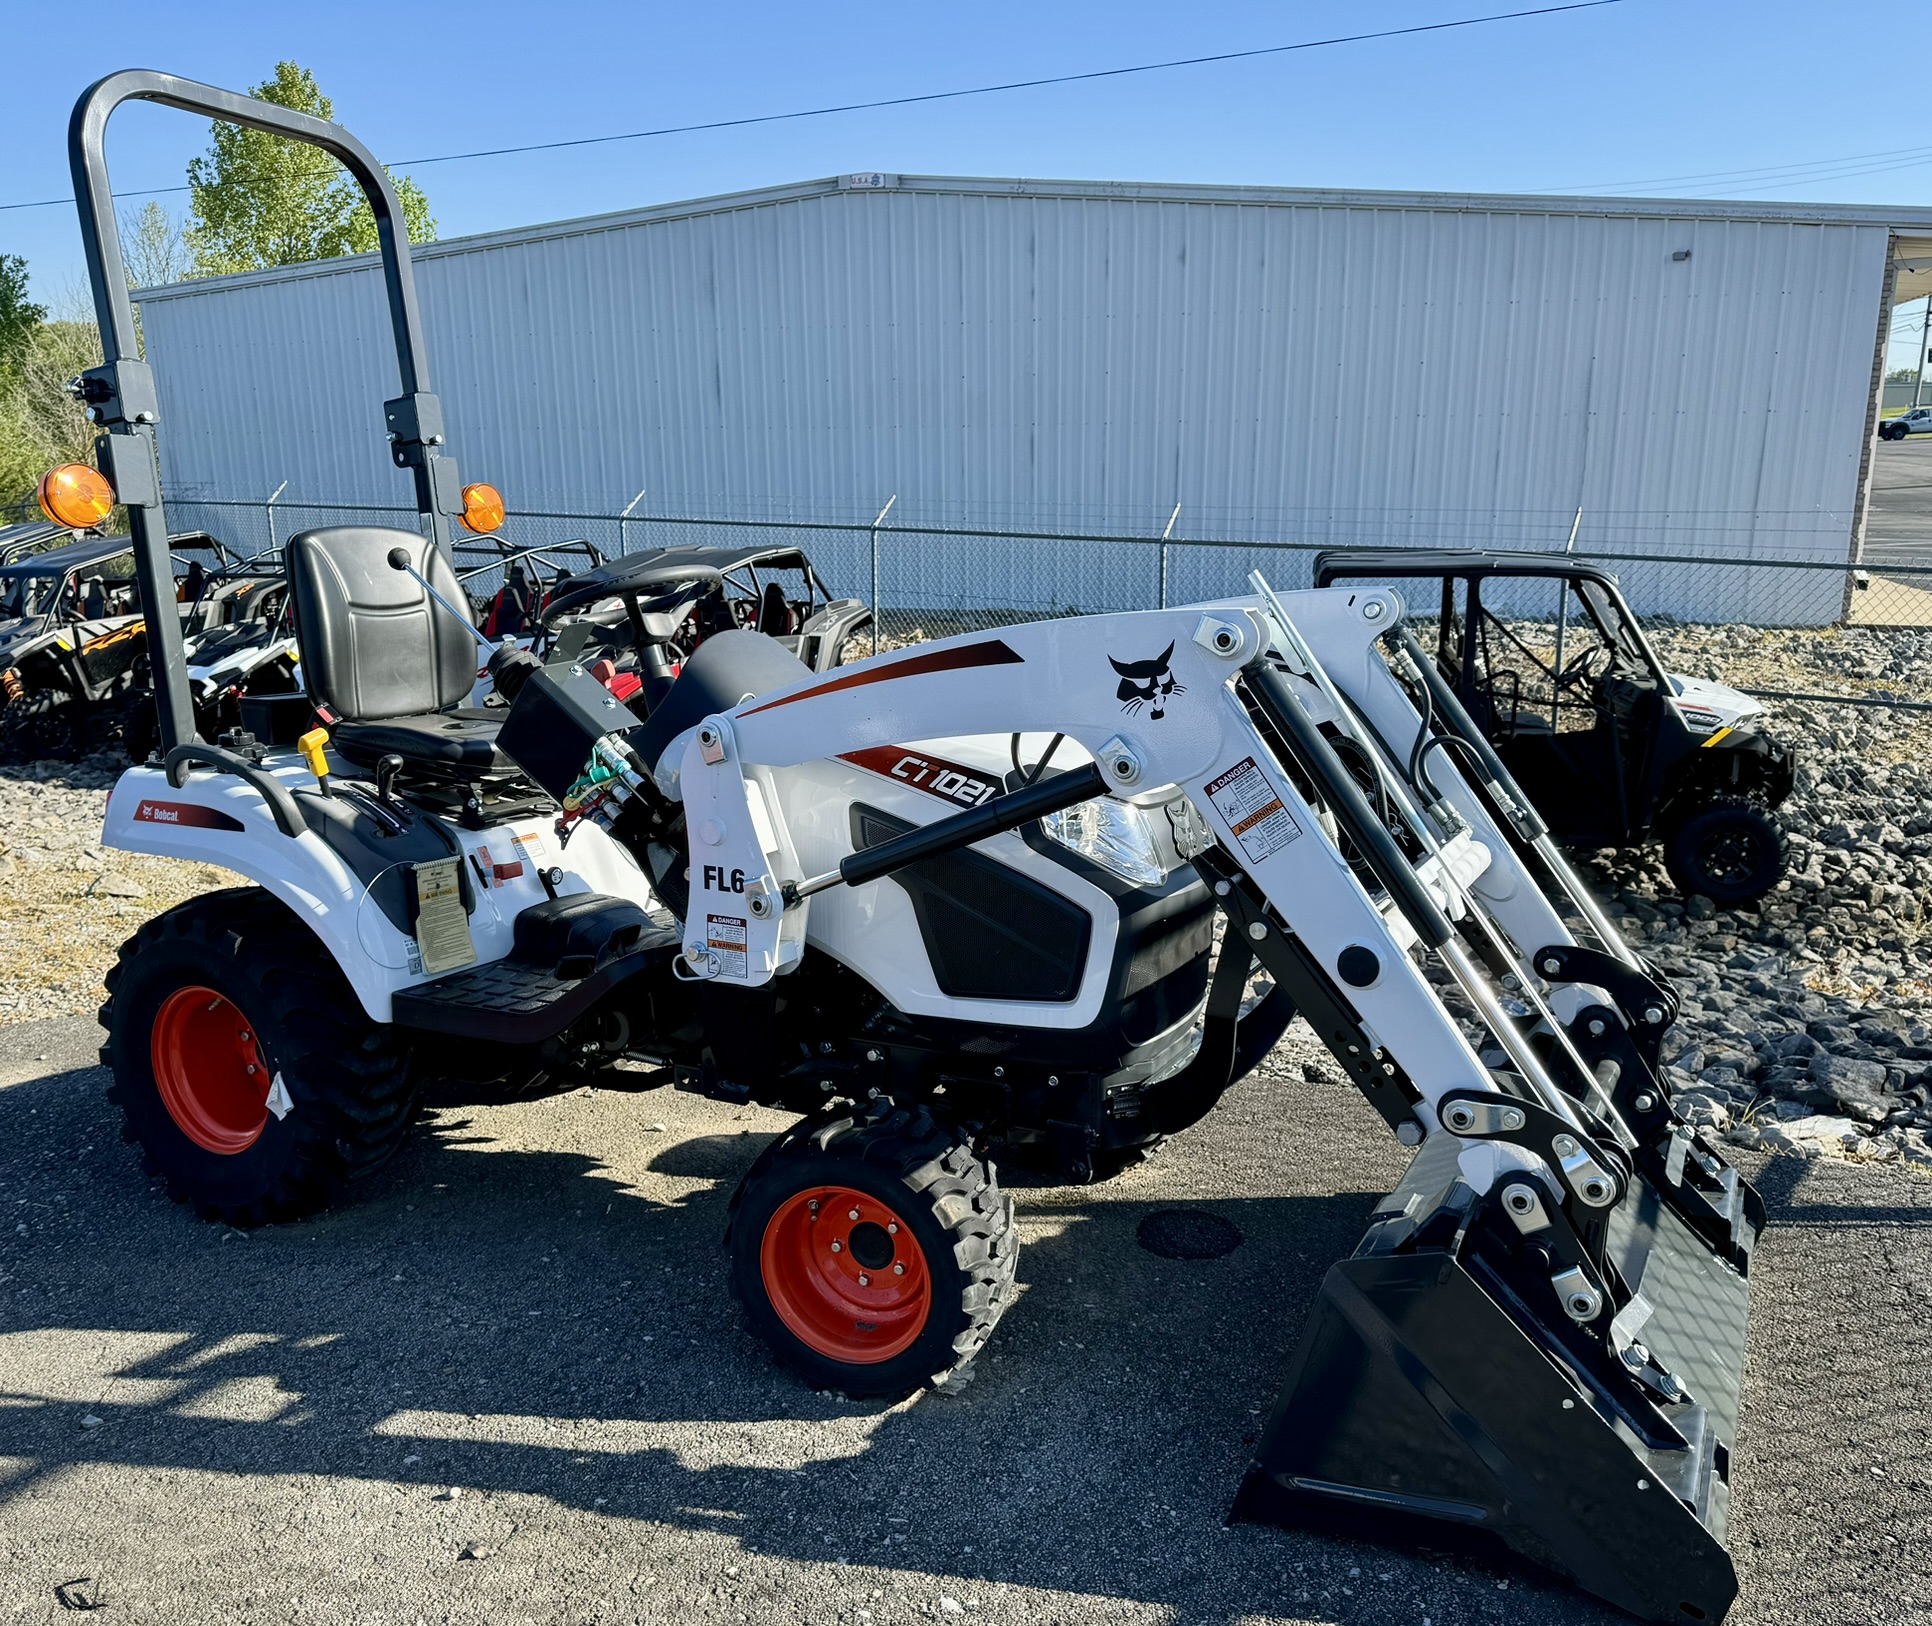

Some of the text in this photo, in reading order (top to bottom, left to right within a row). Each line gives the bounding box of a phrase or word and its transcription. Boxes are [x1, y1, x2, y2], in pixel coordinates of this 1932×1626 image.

[1685, 712, 1720, 724] 1000
[891, 755, 996, 807] CT1021
[1217, 761, 1251, 787] DANGER
[153, 808, 179, 821] Bobcat
[1243, 803, 1278, 829] WARNING
[703, 864, 745, 894] FL6
[717, 916, 742, 926] DANGER
[716, 942, 743, 951] WARNING
